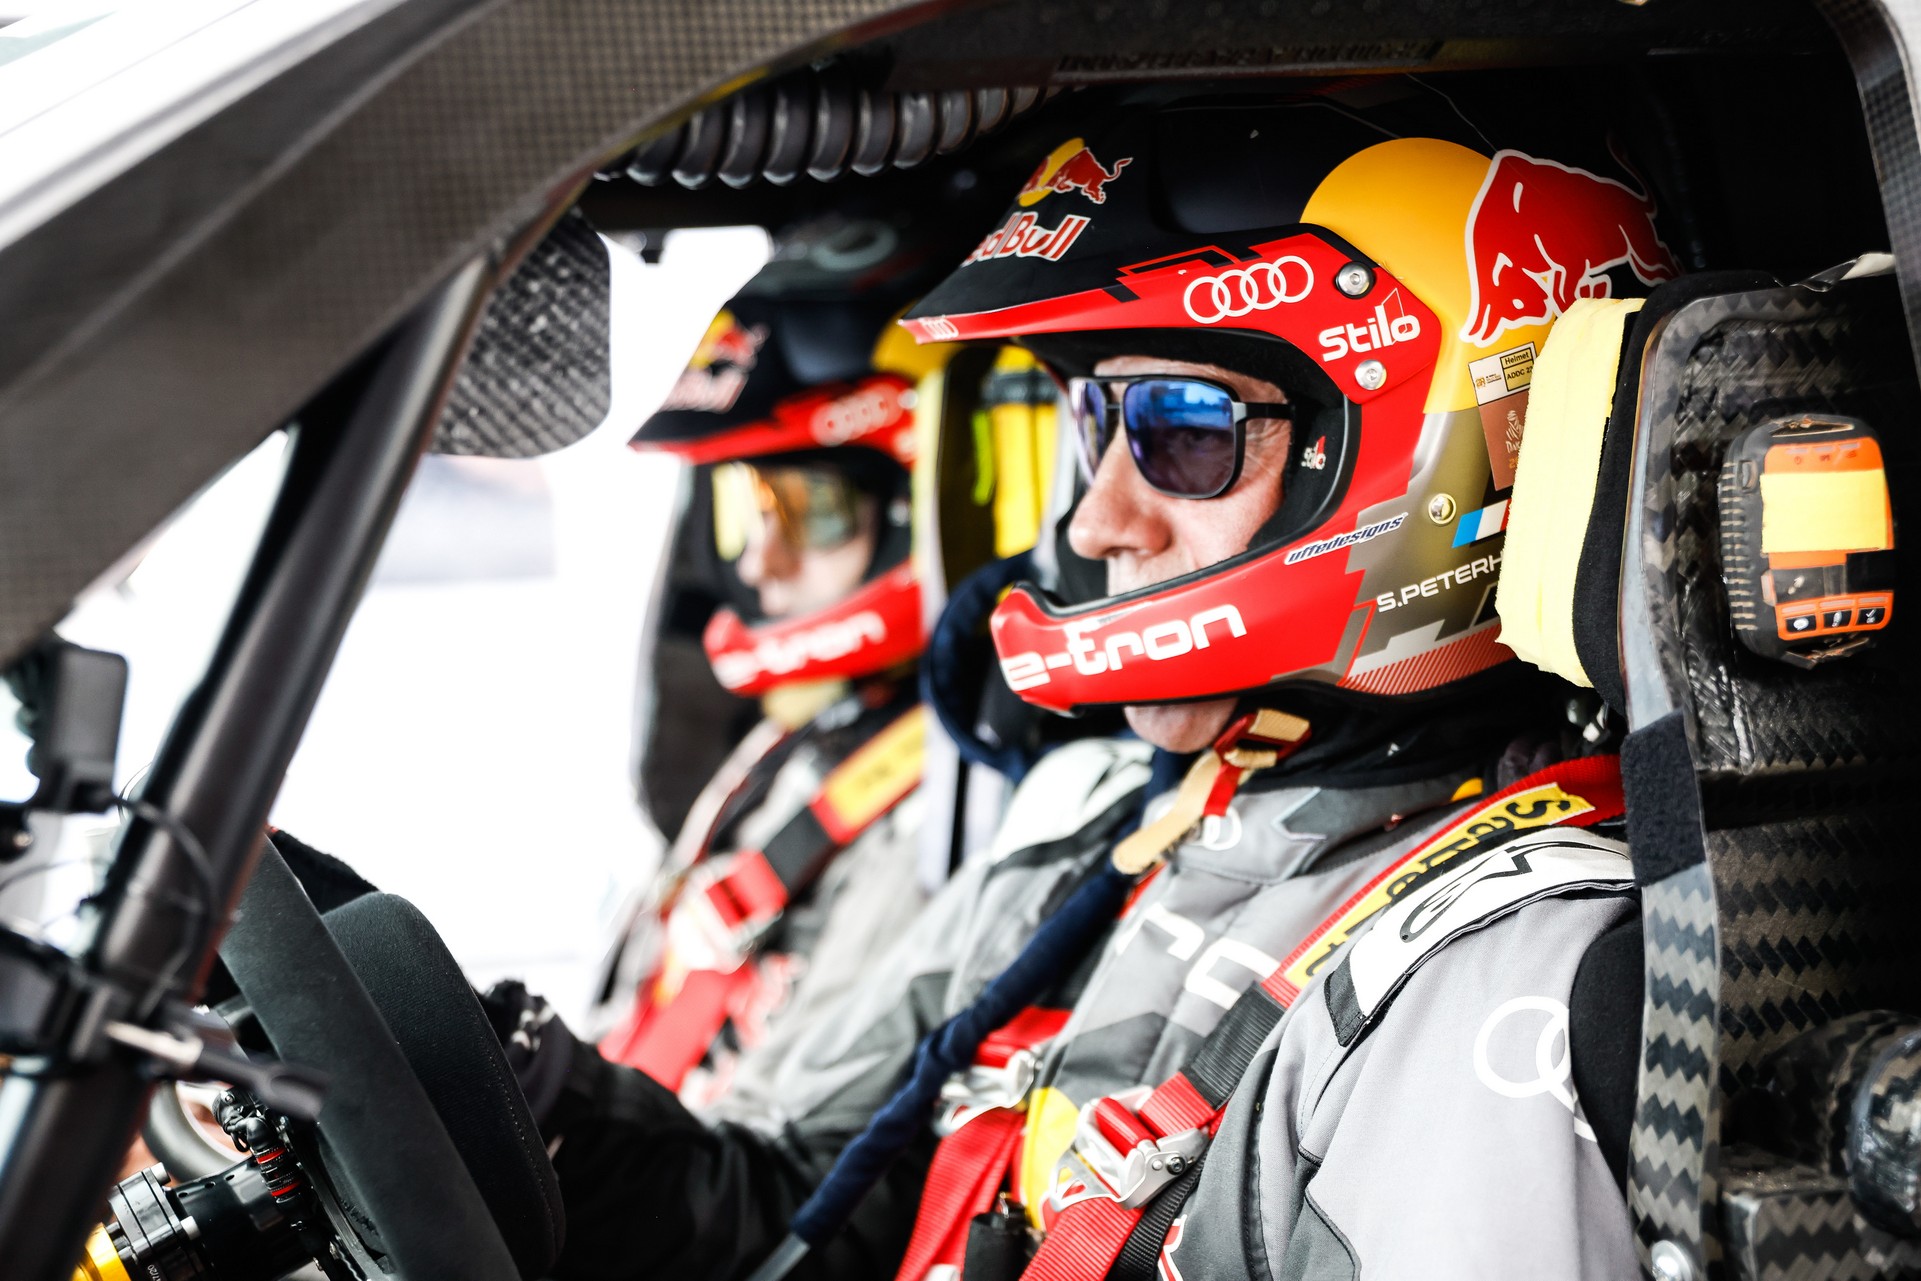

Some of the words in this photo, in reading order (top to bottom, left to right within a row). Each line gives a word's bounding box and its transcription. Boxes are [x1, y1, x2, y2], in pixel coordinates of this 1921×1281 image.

[1319, 300, 1420, 362] stilo
[1504, 352, 1530, 365] Helmet
[1286, 515, 1405, 563] uffedesigns
[1001, 603, 1247, 692] e-tron
